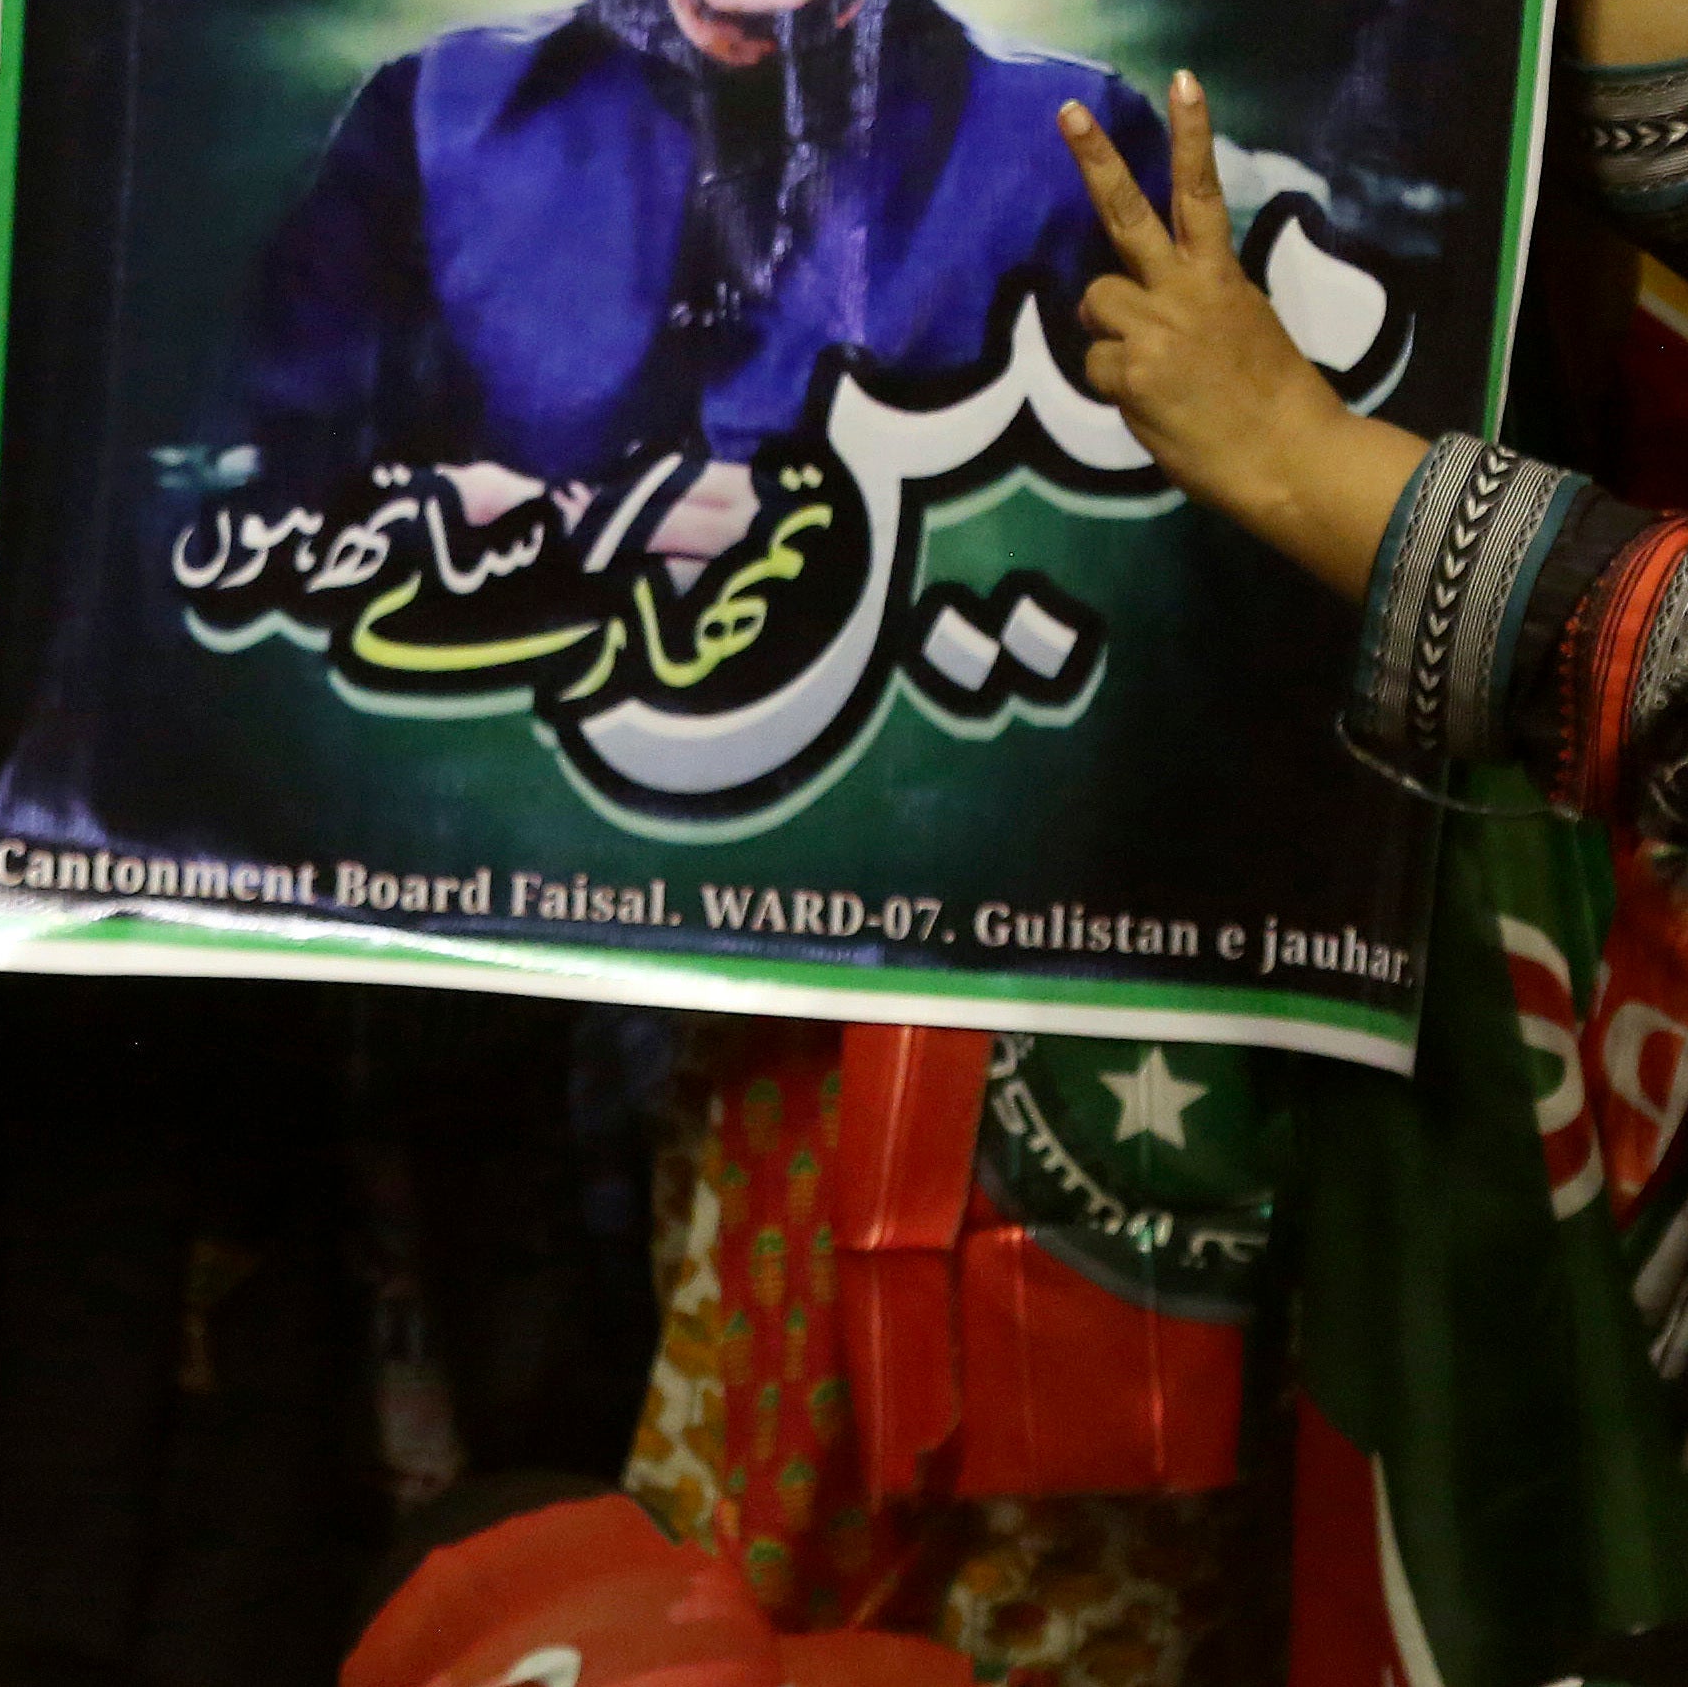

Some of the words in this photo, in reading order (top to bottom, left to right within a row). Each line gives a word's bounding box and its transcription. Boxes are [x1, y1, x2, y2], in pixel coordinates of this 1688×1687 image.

[334, 860, 493, 916] Board
[511, 871, 683, 928] Faisal.
[699, 882, 957, 945] WARD-07.
[973, 899, 1200, 960] Gulistan
[1217, 922, 1245, 961] e
